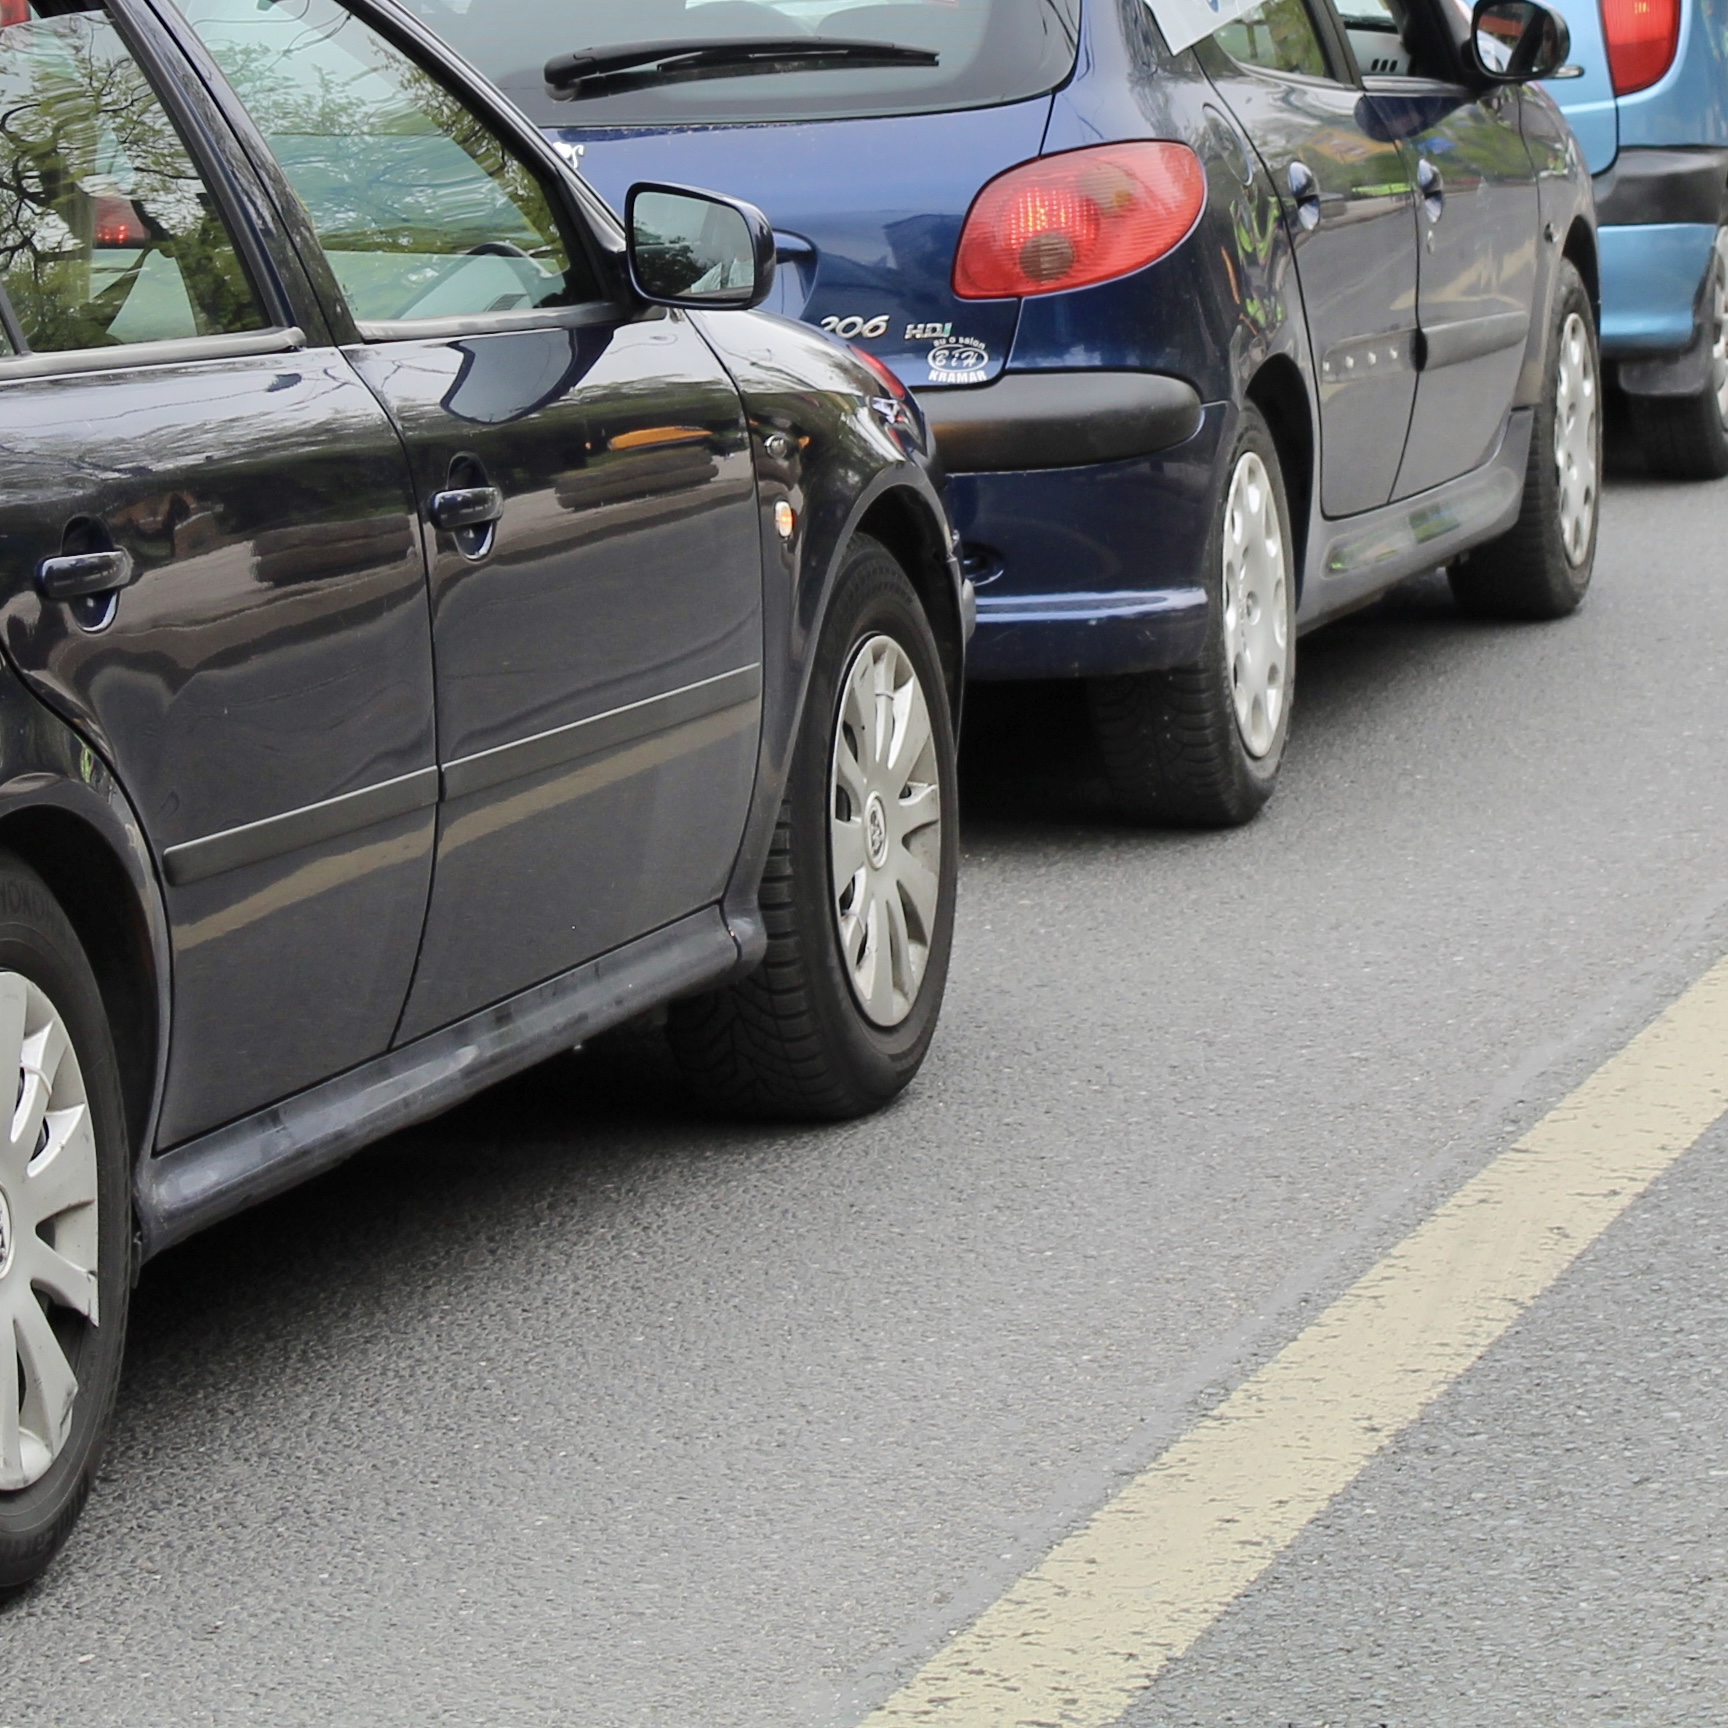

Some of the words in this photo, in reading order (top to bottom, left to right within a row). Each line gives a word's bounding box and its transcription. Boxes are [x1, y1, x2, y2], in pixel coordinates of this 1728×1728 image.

[821, 314, 890, 339] 206
[904, 322, 953, 340] HDI
[958, 337, 986, 351] salon
[934, 350, 979, 368] BiH
[928, 369, 988, 384] KRAMAR
